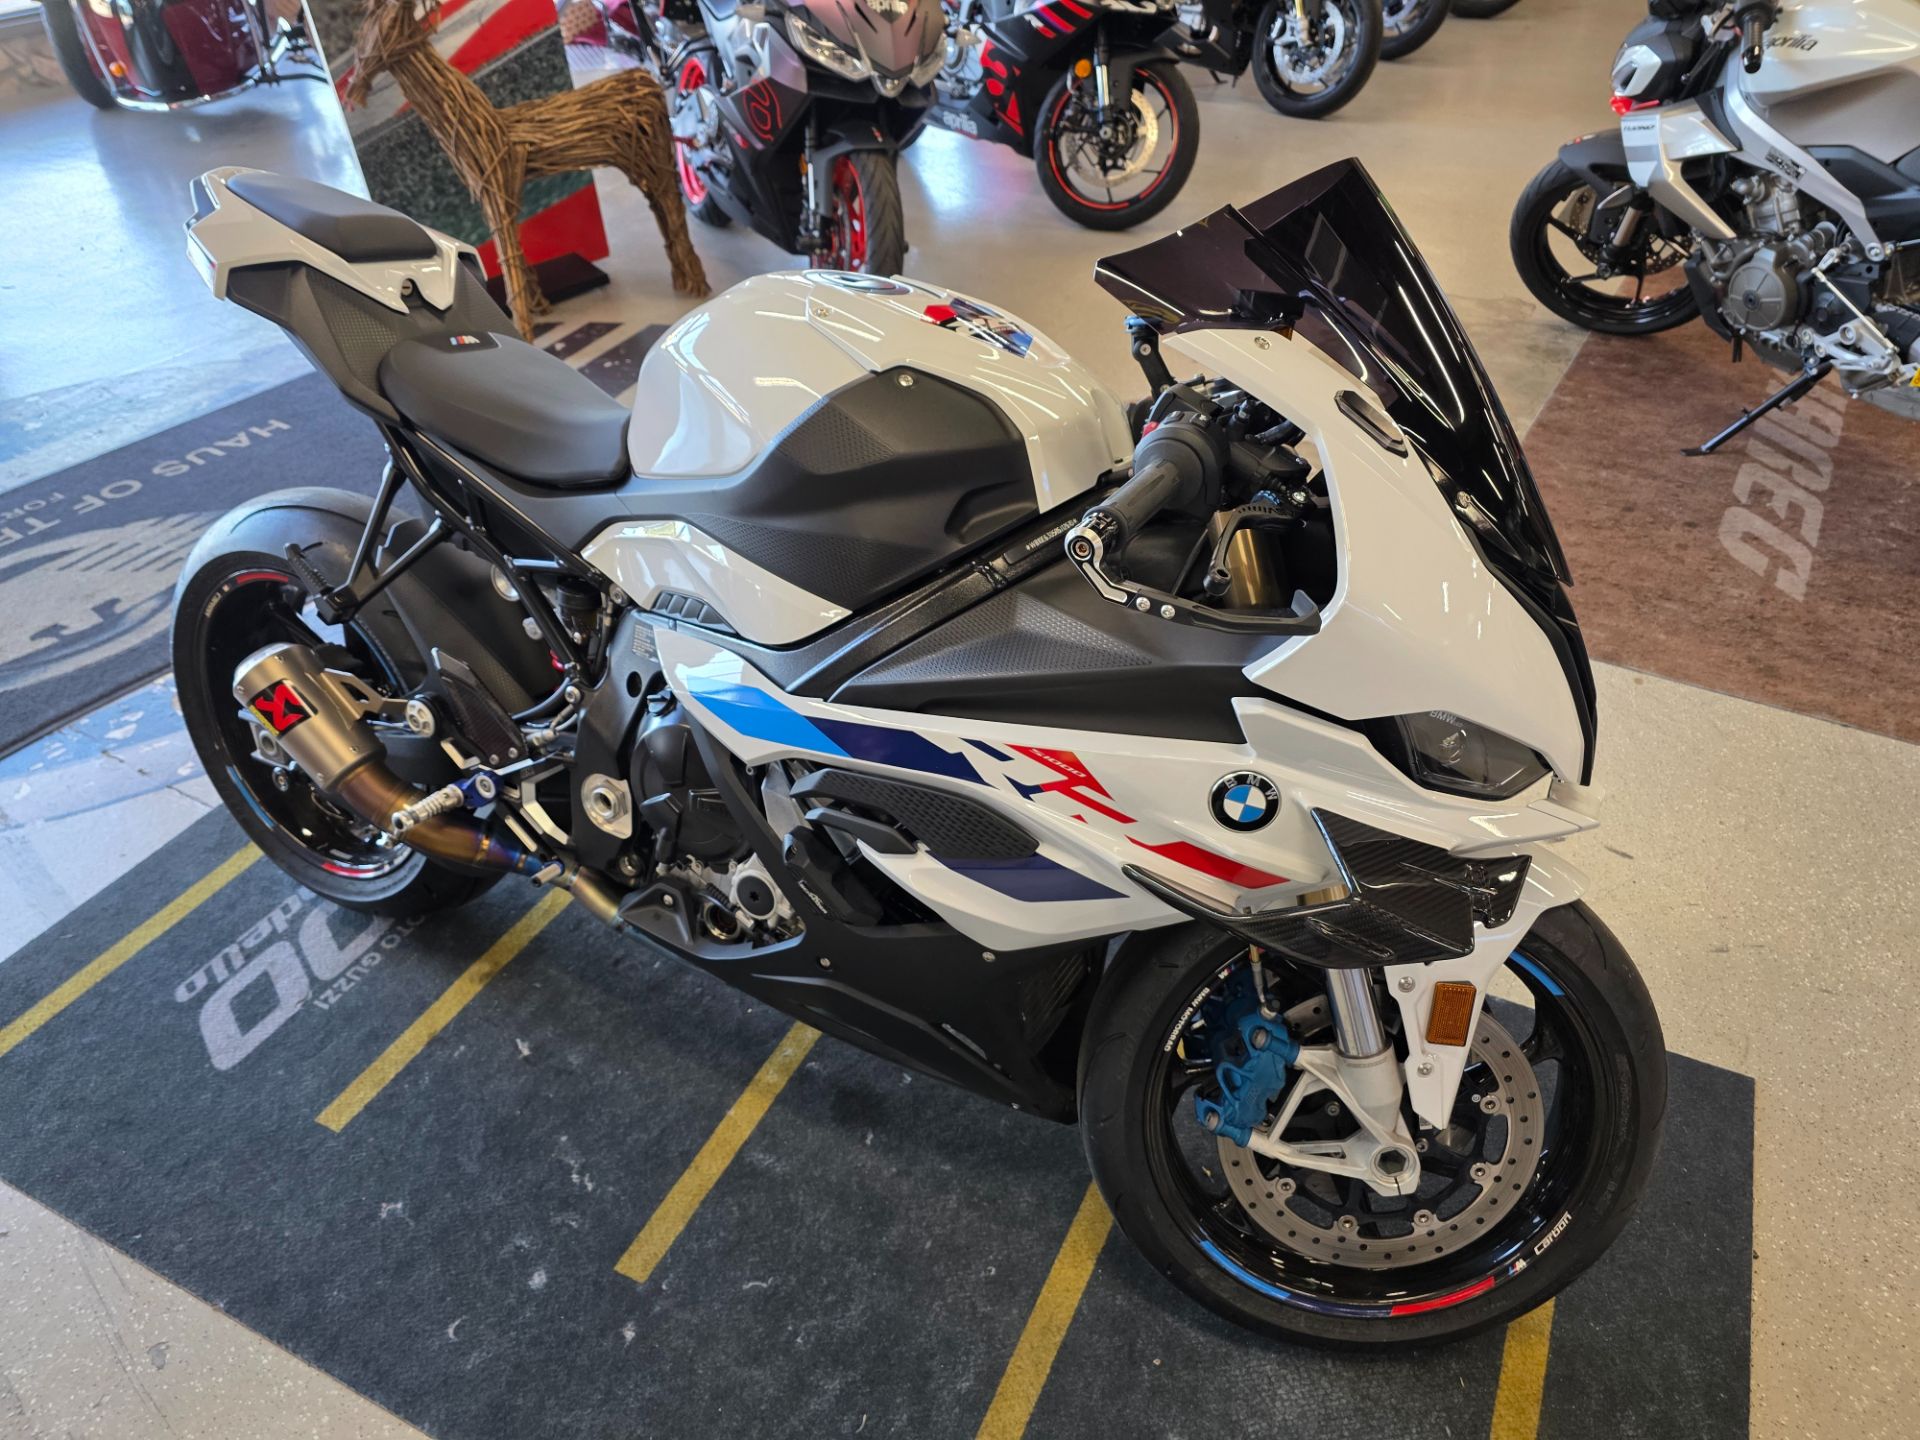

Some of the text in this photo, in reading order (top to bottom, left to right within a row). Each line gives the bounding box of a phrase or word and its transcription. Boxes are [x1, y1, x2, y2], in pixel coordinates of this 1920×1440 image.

[1766, 34, 1818, 51] prilia
[152, 418, 292, 478] HAUS
[72, 479, 144, 516] OF
[1030, 747, 1088, 778] S1000
[1223, 773, 1278, 801] BMW
[313, 950, 383, 1010] GUZZI
[1163, 1006, 1195, 1052] MOTORRAD
[1533, 1210, 1573, 1256] Carbon
